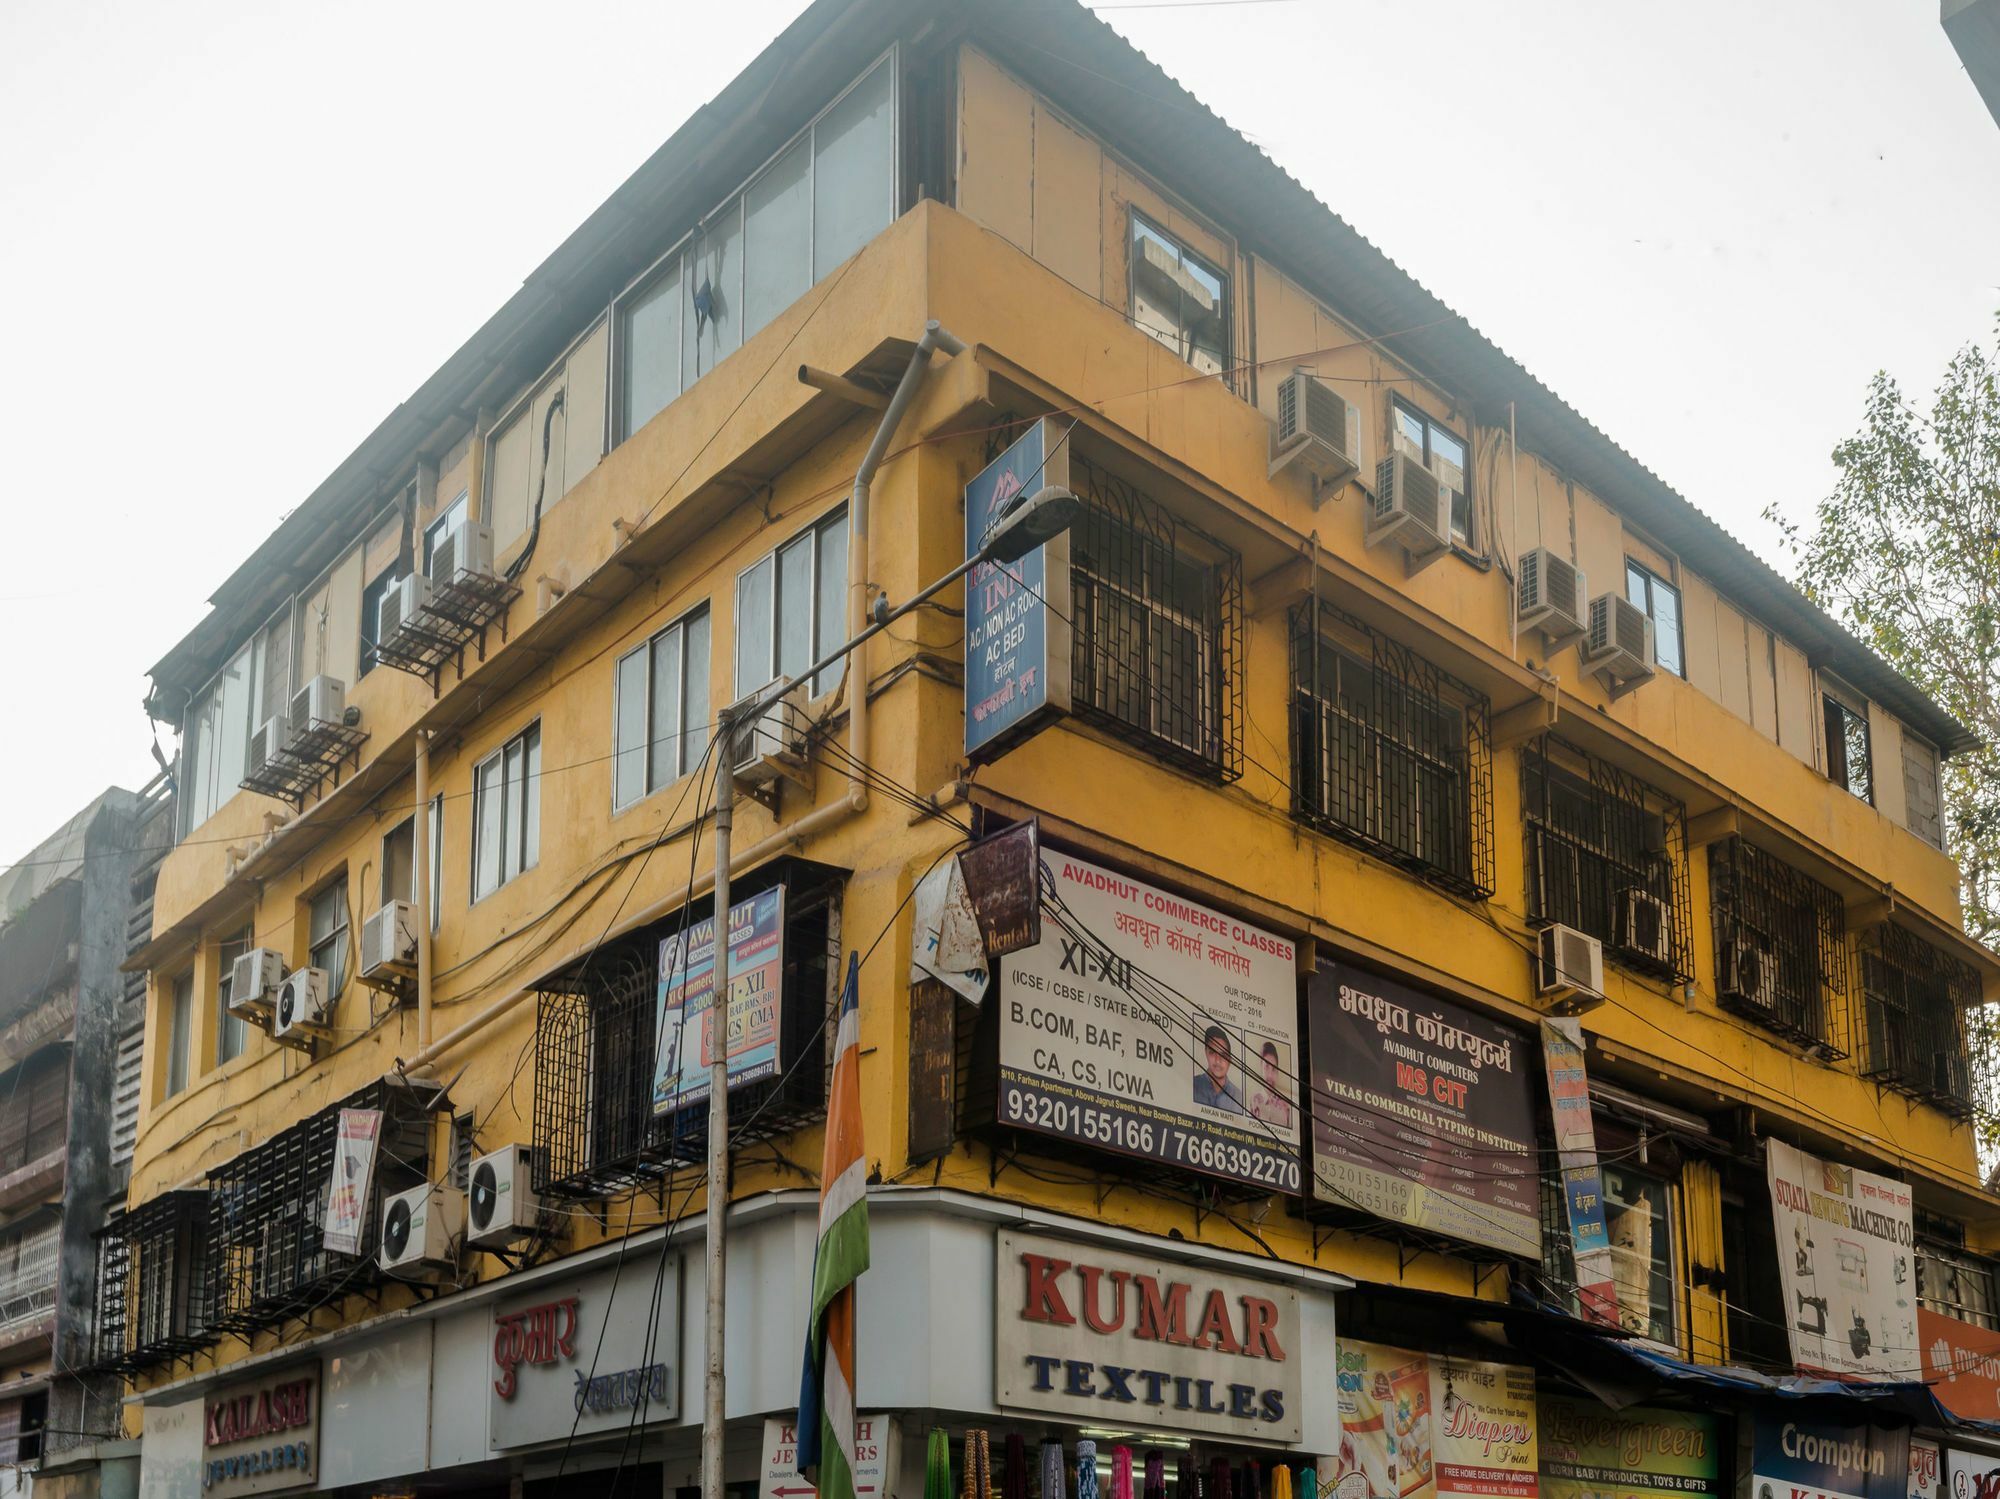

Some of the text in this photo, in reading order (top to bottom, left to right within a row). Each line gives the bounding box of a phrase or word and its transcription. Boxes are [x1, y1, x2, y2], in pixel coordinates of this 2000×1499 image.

[984, 558, 1024, 614] INN
[970, 627, 981, 652] AC
[987, 611, 1004, 640] NON
[1005, 602, 1016, 627] AC
[1018, 582, 1041, 618] ROOM
[986, 623, 1025, 668] AC BED
[689, 901, 755, 948] AVAHUT
[1062, 863, 1139, 902] AVADHUT
[1144, 893, 1228, 936] COMMERCE
[1232, 926, 1293, 961] CLASSES
[1059, 938, 1132, 991] XI-XII
[1114, 911, 1251, 978] अवधूत कॉमर्स क्लासेस
[745, 970, 765, 996] XII
[1012, 969, 1043, 993] (ICSE
[1053, 983, 1084, 1005] CBSE
[1094, 995, 1128, 1017] STATE
[1131, 1008, 1173, 1033] BOARD)
[1224, 985, 1266, 1007] OUR TOPPER
[728, 1018, 742, 1038] CS
[750, 1005, 774, 1028] CMA
[1011, 1001, 1174, 1068] B.COM, BAF, BMS
[1209, 1007, 1236, 1022] EXECUTIVE
[1229, 1000, 1262, 1018] DEC 2016
[1258, 1024, 1289, 1038] FOUNDATION
[1339, 985, 1410, 1035] अवधूत
[1033, 1049, 1154, 1101] CA, CS, ICWA
[1384, 1038, 1479, 1085] AVADHUT COMPUTERS
[1396, 1062, 1468, 1110] MS CIT
[1018, 1073, 1039, 1087] Farhan
[1075, 1090, 1094, 1102] Above
[1139, 1106, 1152, 1117] Near
[1153, 1110, 1176, 1126] Bombay
[1326, 1079, 1362, 1101] VIKAS
[1365, 1092, 1435, 1127] COMMERCIAL
[1437, 1116, 1475, 1139] TYPING
[1477, 1129, 1528, 1157] INSTITUTE
[1332, 1110, 1357, 1124] ADVANCE
[1008, 1089, 1153, 1153] 9320155166
[1175, 1132, 1300, 1190] 7666392270
[1320, 1161, 1407, 1198] 9320155166
[1455, 1183, 1476, 1196] ORACLE
[1776, 1178, 1811, 1215] SUJATA
[1810, 1191, 1850, 1229] SEWING
[1849, 1205, 1897, 1243] MACHINE
[1022, 1252, 1286, 1361] KUMAR
[494, 1298, 579, 1399] कुमार
[205, 1379, 309, 1447] KALASH
[1027, 1355, 1285, 1423] TEXTILES
[1486, 1405, 1497, 1414] Care
[1505, 1408, 1516, 1417] Your
[1516, 1411, 1528, 1419] Baby
[1443, 1399, 1532, 1457] Diapers
[1546, 1402, 1705, 1467] Evergreen
[1782, 1423, 1885, 1476] Crompton
[203, 1441, 307, 1488] JEWELLERS
[1445, 1467, 1460, 1477] FREE
[1460, 1470, 1477, 1479] HOME
[1478, 1472, 1505, 1481] DELIVERY
[1511, 1475, 1534, 1483] ANDHERI
[1496, 1446, 1529, 1464] Point
[1550, 1464, 1574, 1477] BORN
[1576, 1468, 1600, 1481] BABY
[1602, 1472, 1651, 1487] PRODUCTS,
[1653, 1476, 1673, 1488] TOYS
[1684, 1480, 1706, 1491] GIFTS
